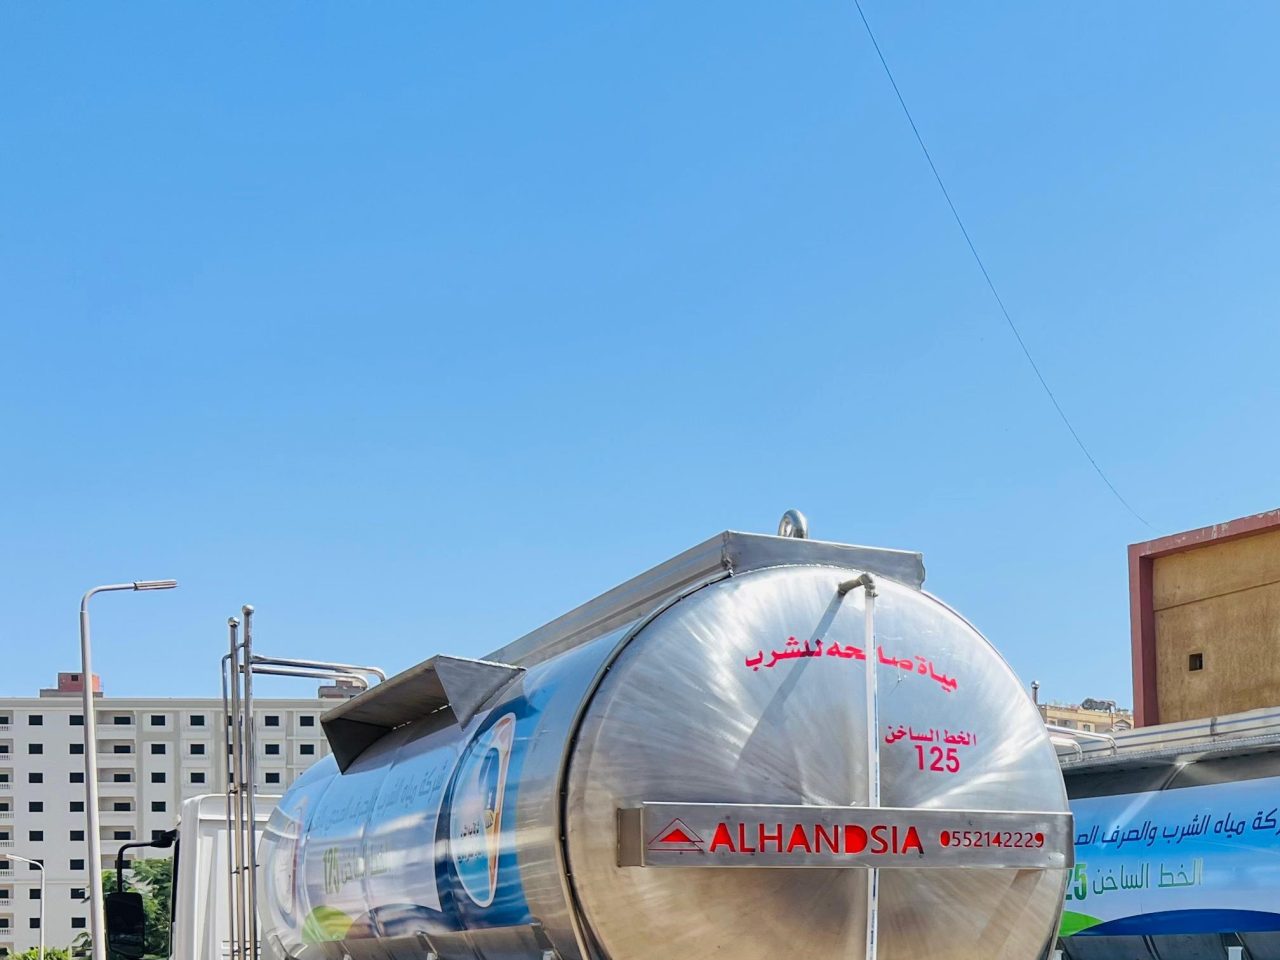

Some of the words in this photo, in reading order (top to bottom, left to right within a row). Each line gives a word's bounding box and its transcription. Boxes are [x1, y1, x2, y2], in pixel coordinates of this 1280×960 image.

[745, 636, 824, 672] للشرب
[826, 640, 914, 672] صاحه
[884, 725, 940, 744] الساخن
[943, 729, 977, 746] الخط
[914, 744, 960, 773] 125
[709, 821, 925, 855] ALHANDSIA
[940, 830, 1045, 848] 0552142229
[1074, 826, 1099, 846] الص
[1101, 821, 1157, 849] والصرف
[1162, 814, 1212, 844] الشرب
[1213, 813, 1246, 838] مياه
[1092, 862, 1149, 895] الساخن
[1158, 858, 1203, 888] الخط
